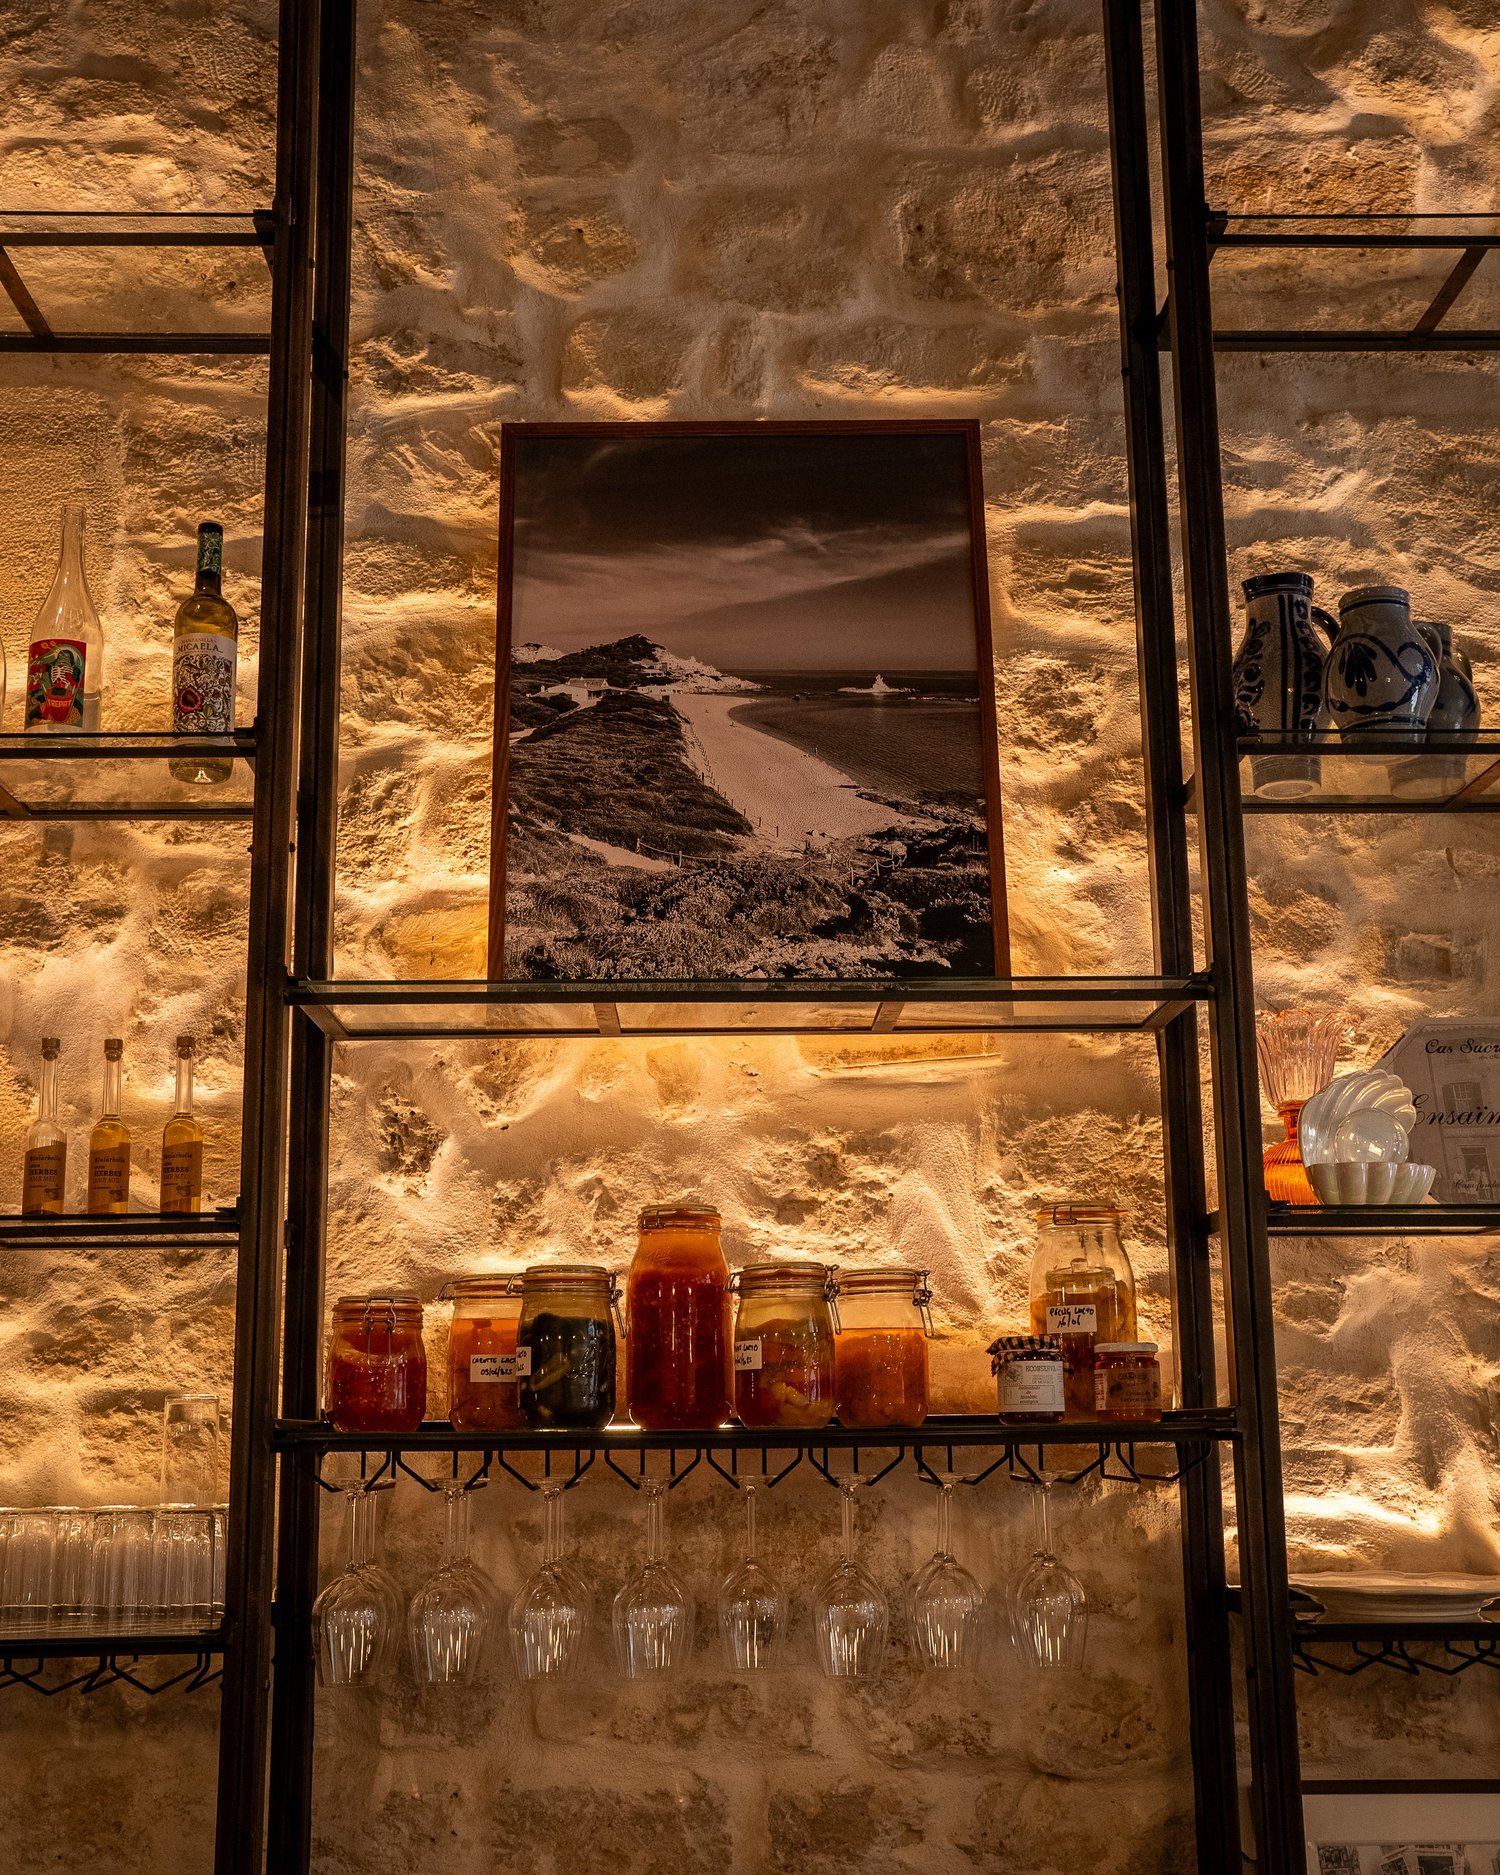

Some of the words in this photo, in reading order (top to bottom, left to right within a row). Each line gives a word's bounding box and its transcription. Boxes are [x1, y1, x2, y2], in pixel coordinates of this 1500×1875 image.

[177, 643, 222, 654] MICAELA
[1425, 1039, 1453, 1054] Cas
[29, 1168, 58, 1176] HERBES
